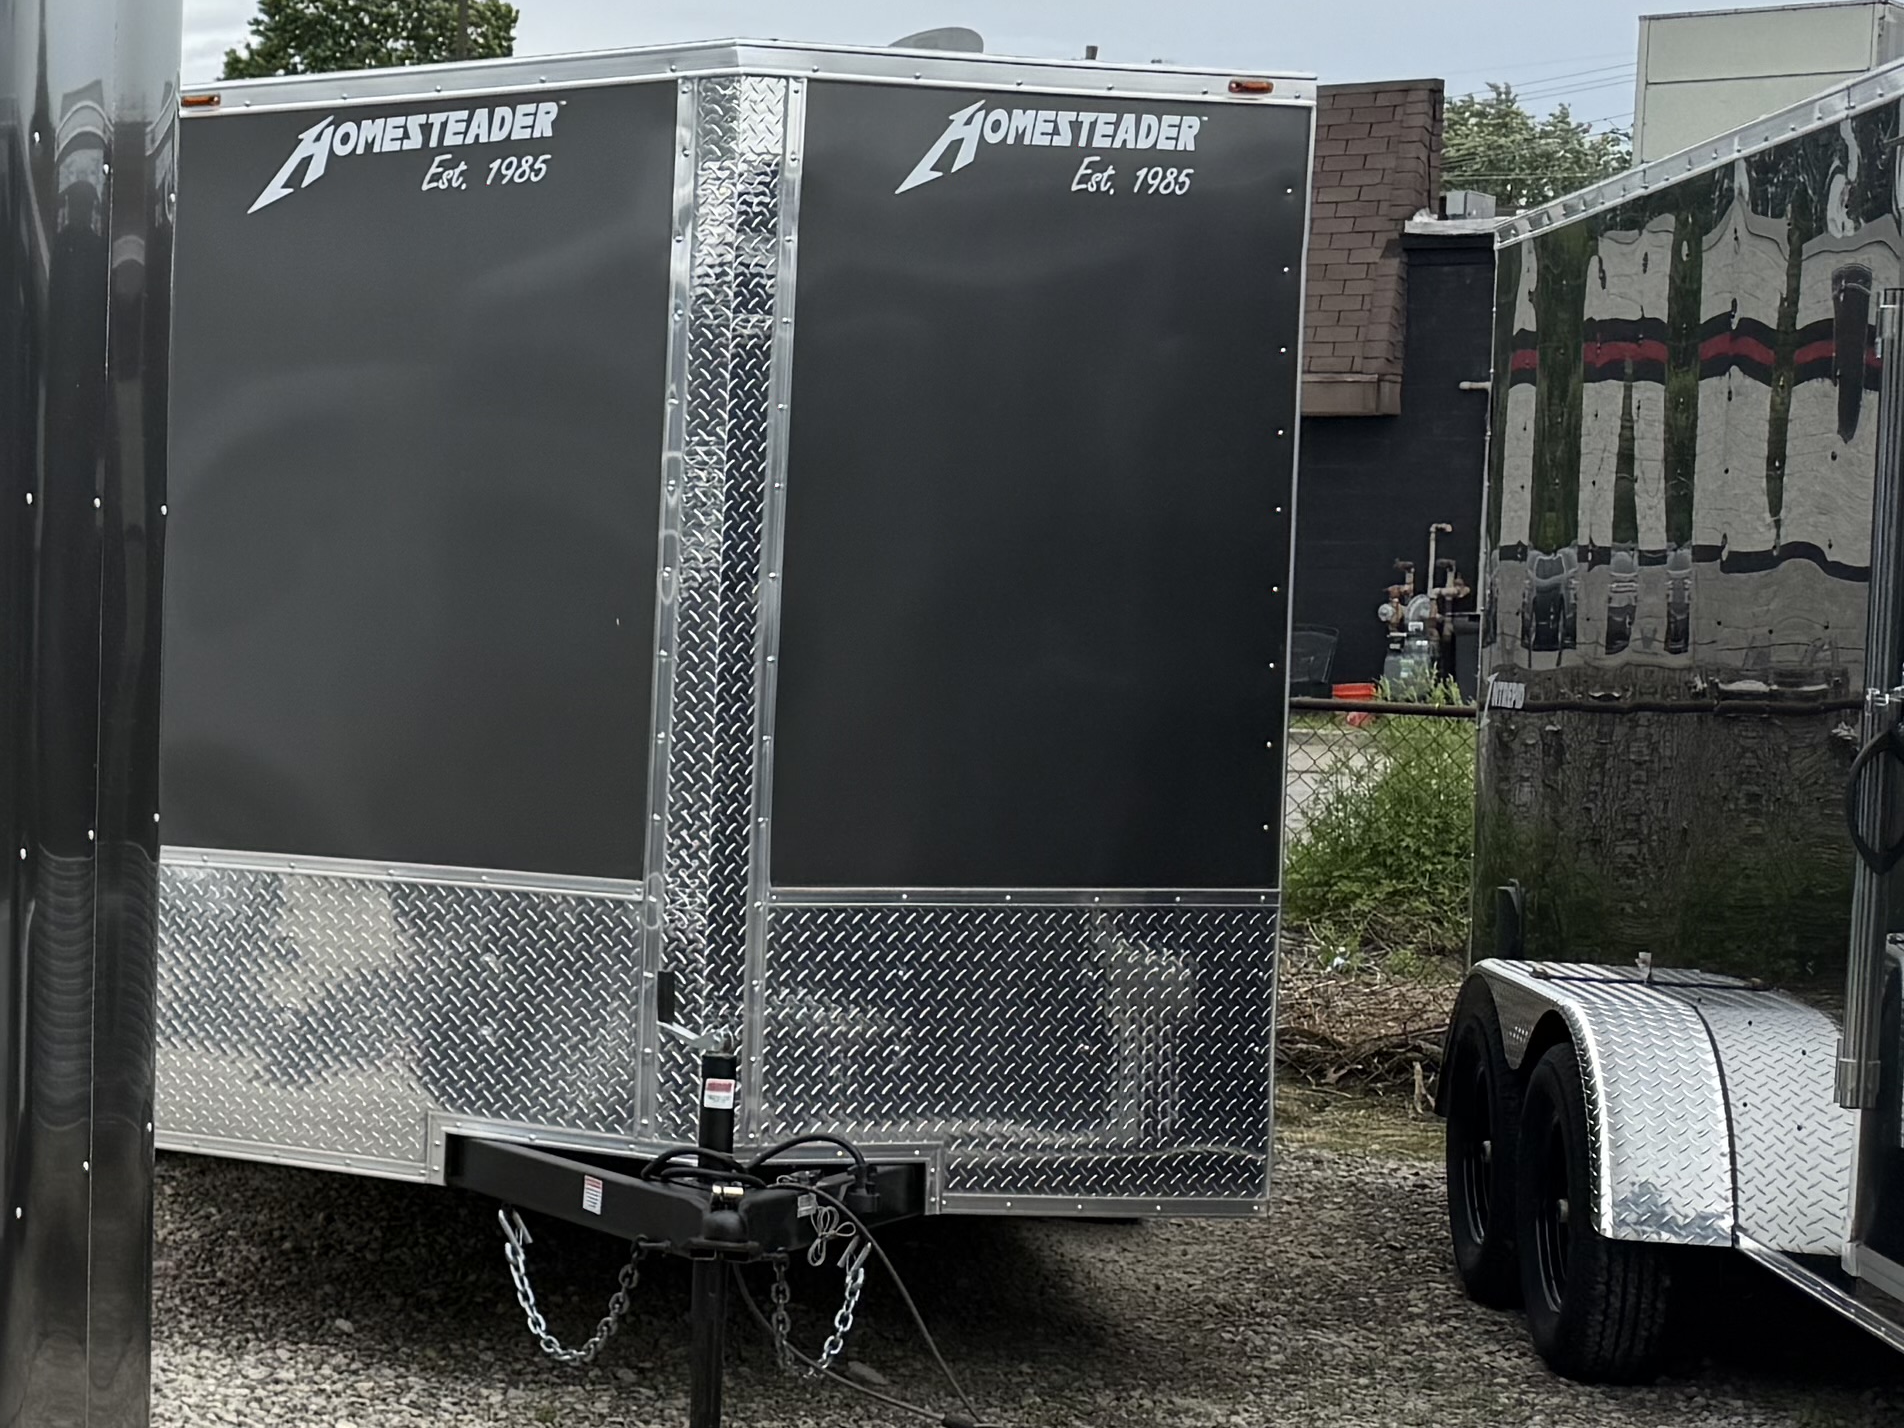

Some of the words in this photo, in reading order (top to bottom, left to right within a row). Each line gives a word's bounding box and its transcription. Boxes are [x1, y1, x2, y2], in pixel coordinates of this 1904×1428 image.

[247, 101, 559, 214] HOMESTEADER
[421, 153, 468, 192] Est.
[485, 153, 552, 186] 1985
[894, 99, 1201, 194] HOMESTEADER
[1070, 155, 1116, 195] Est.
[1132, 167, 1194, 196] 1985
